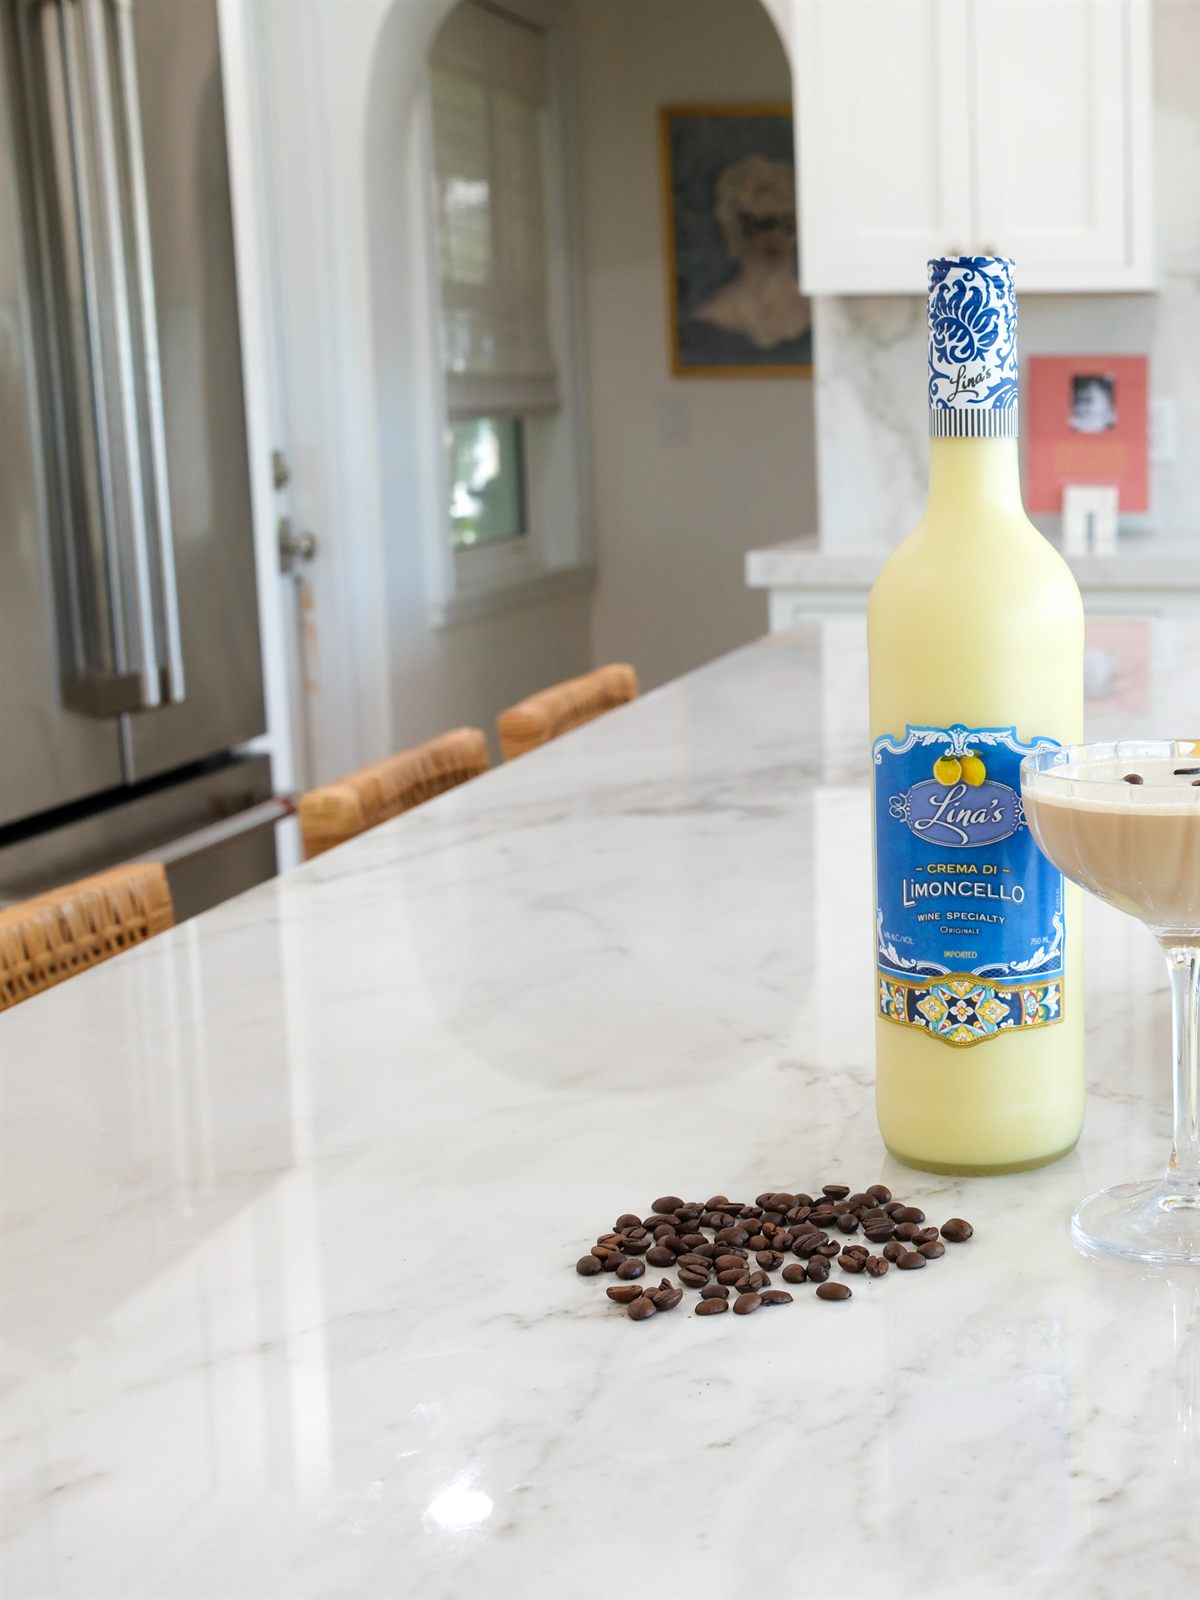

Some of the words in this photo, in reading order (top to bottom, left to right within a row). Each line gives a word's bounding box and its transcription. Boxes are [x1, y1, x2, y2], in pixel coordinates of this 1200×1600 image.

[946, 364, 992, 402] Lina's
[914, 784, 1005, 845] Lina's
[927, 863, 978, 874] CREMA
[982, 864, 998, 874] DI
[917, 912, 941, 922] WINE
[946, 912, 1006, 924] SPECIALTY
[1030, 937, 1042, 945] 750
[944, 950, 978, 959] IMPORTED
